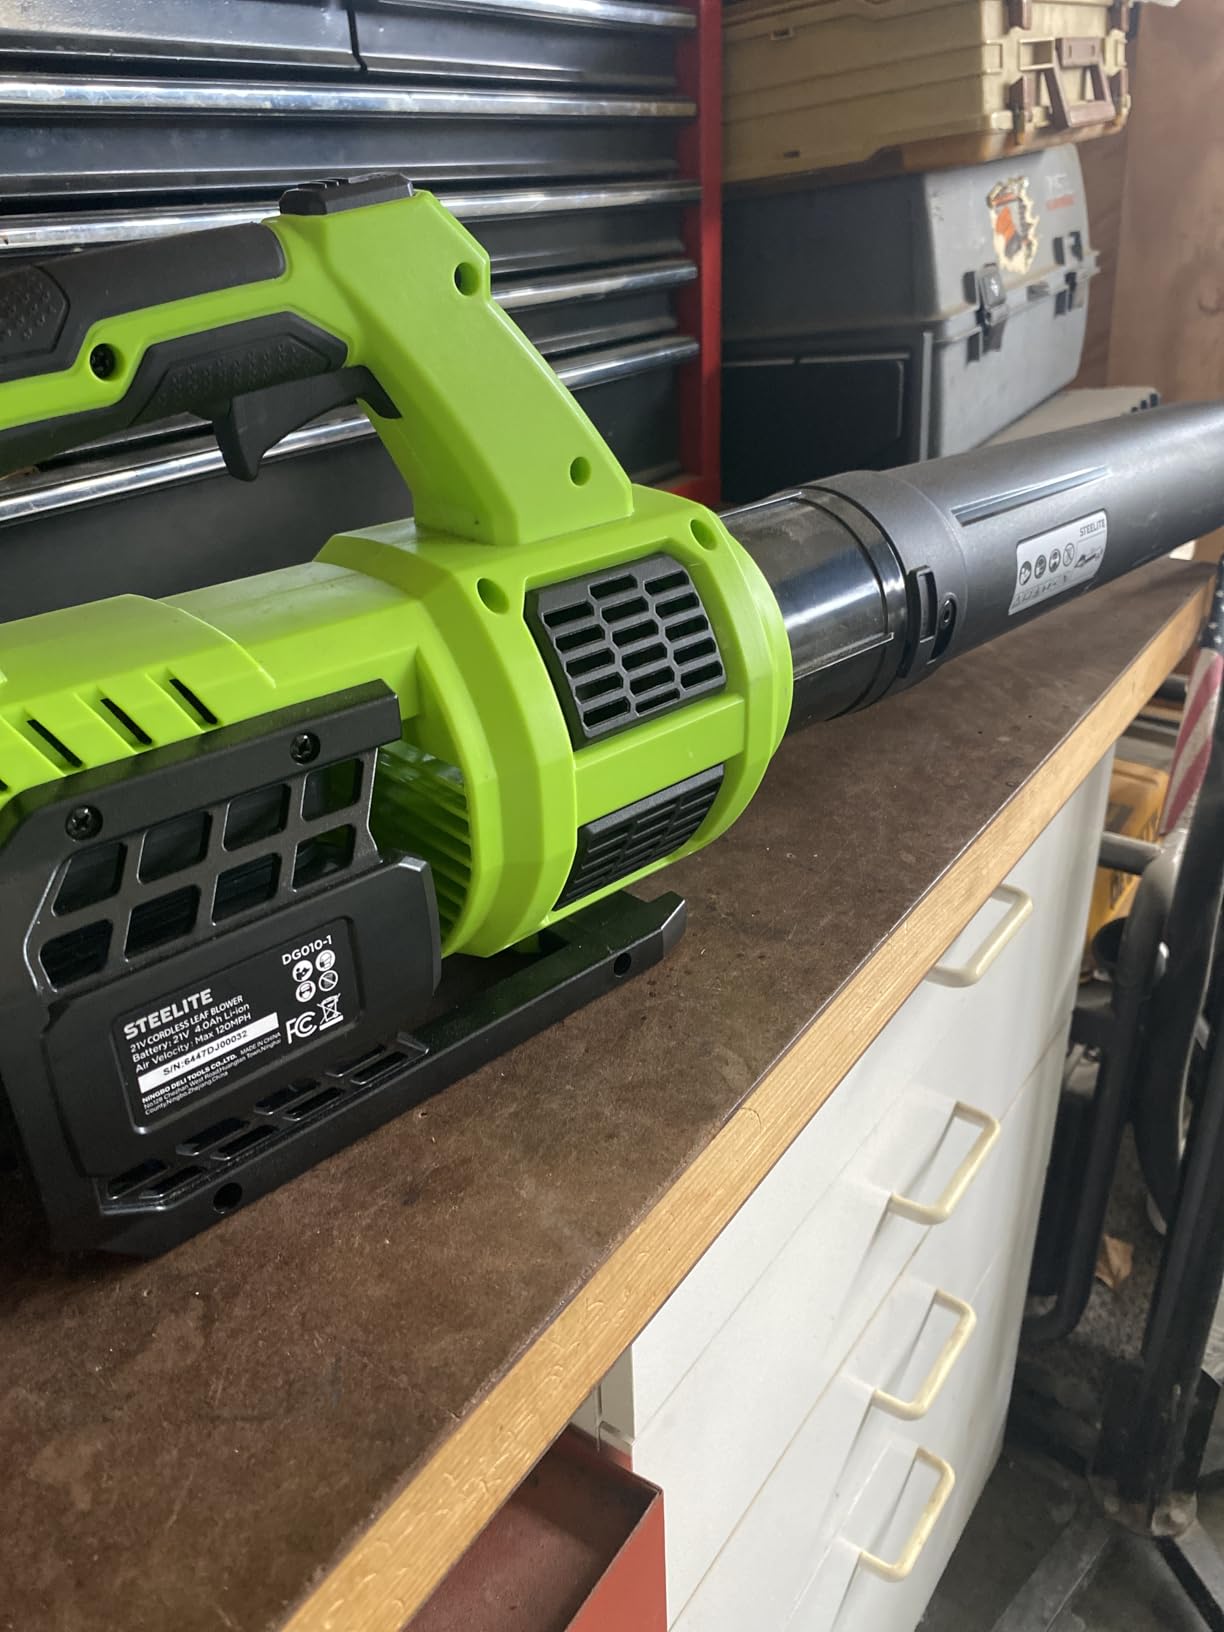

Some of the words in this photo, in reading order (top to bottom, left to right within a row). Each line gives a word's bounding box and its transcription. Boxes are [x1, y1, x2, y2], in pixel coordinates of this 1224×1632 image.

[1080, 519, 1105, 536] STEELITE
[282, 935, 332, 965] DG010-1
[124, 987, 213, 1040] STEELITE
[130, 1040, 147, 1052] 21V
[147, 1020, 190, 1044] CORDLESS
[190, 1010, 209, 1024] LEAF
[210, 995, 243, 1016] BLOWER
[132, 1040, 172, 1062] Battery:
[173, 1030, 190, 1044] 21V
[194, 1016, 222, 1032] 4.0Ah
[224, 1004, 250, 1020] Li-ion
[136, 1061, 150, 1073] Air
[194, 1032, 214, 1044] Max
[216, 1012, 251, 1034] 120MPH
[142, 1086, 170, 1104] NINGBO
[171, 1078, 187, 1090] DELI
[187, 1066, 210, 1080] TOOLS
[240, 1044, 256, 1055] MADE
[264, 1032, 281, 1044] CHINA
